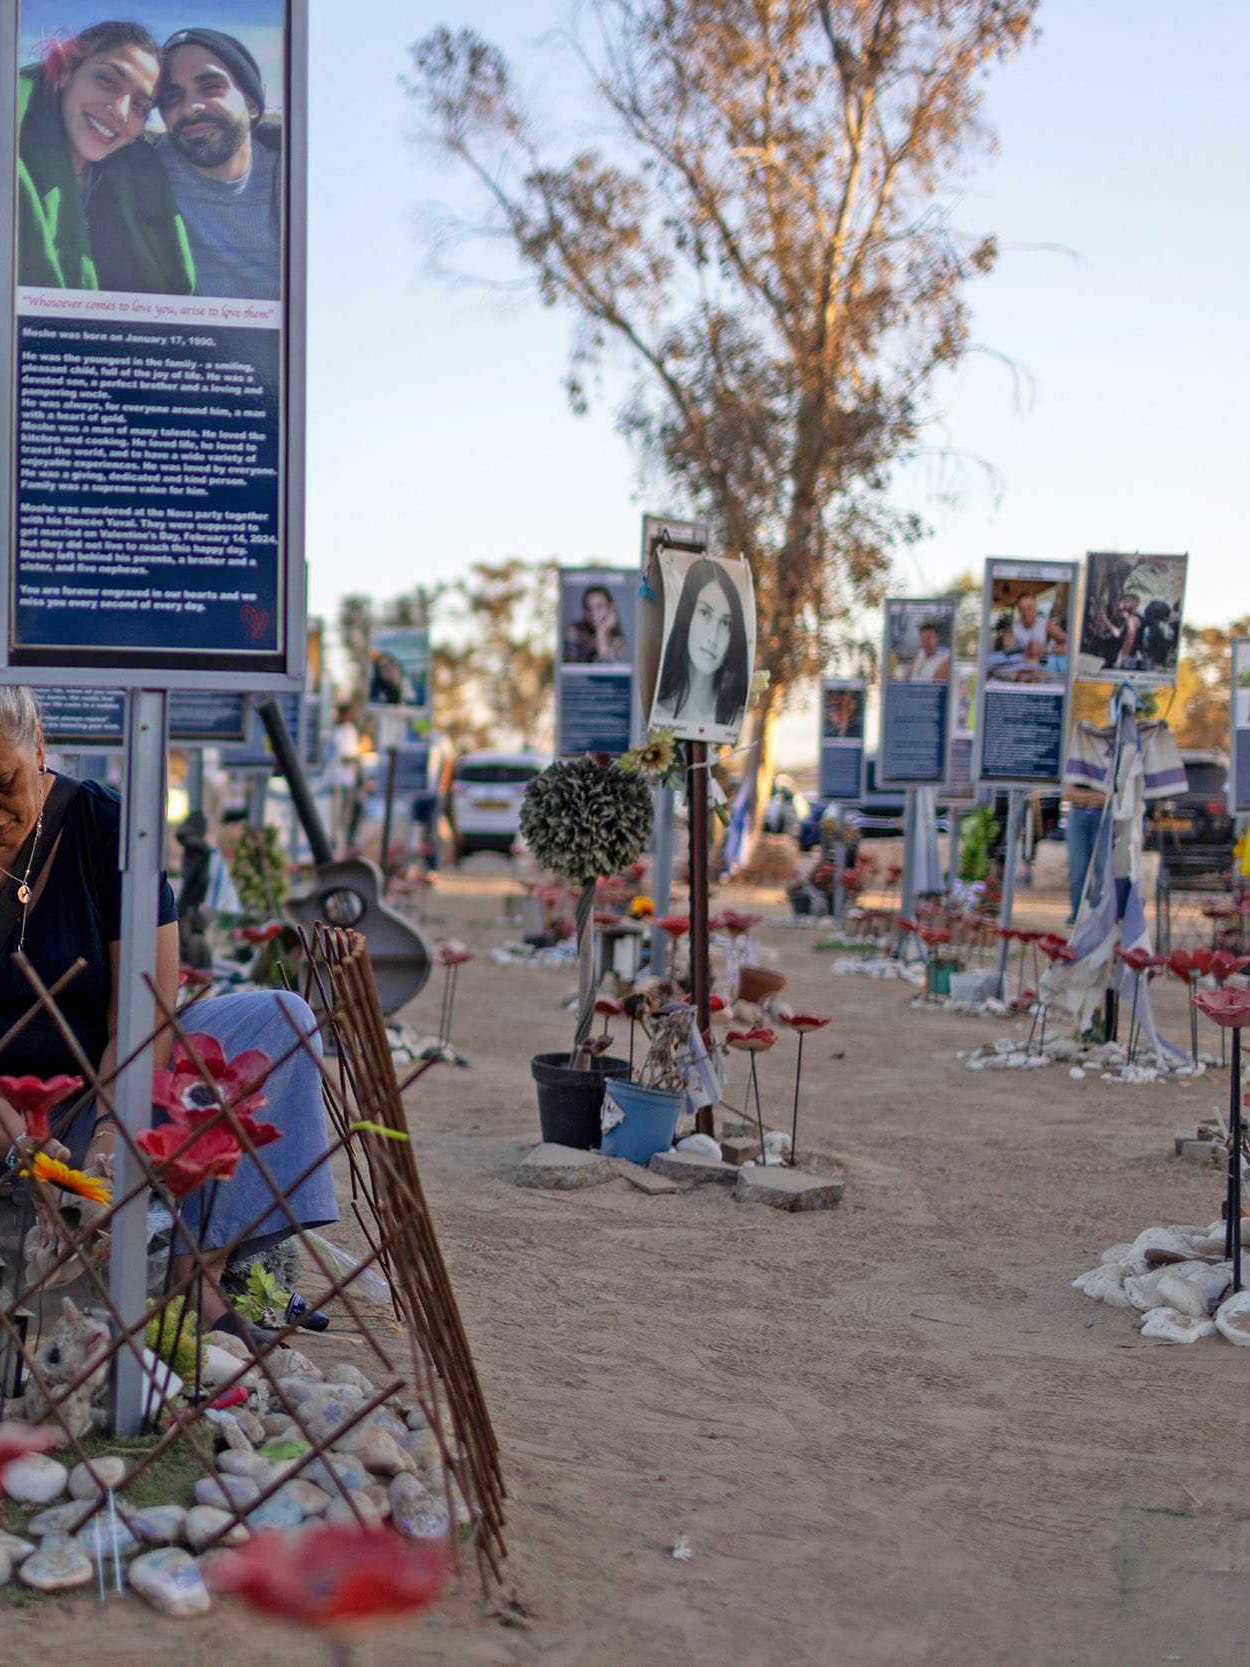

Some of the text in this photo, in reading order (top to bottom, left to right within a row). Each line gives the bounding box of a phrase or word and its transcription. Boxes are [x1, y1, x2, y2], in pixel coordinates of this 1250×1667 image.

[86, 300, 115, 310] comes
[119, 298, 129, 311] to
[132, 299, 151, 312] love
[155, 304, 177, 317] you,
[180, 302, 205, 315] arise
[208, 303, 218, 316] to
[221, 304, 240, 317] love
[244, 305, 274, 319] them"
[21, 326, 56, 338] Moshe
[59, 330, 80, 339] was
[83, 330, 107, 341] born
[109, 333, 122, 341] on
[125, 332, 167, 346] January
[188, 335, 216, 346] 1990.
[21, 350, 37, 360] He
[39, 352, 61, 362] was
[63, 352, 80, 363] the
[83, 353, 130, 367] youngest
[133, 355, 143, 366] in
[145, 356, 162, 367] the
[164, 357, 196, 370] family
[205, 361, 212, 369] a
[21, 385, 111, 399] pampering uncle.
[21, 396, 36, 407] He
[39, 399, 60, 408] was
[104, 400, 119, 411] for
[121, 403, 169, 415] everyone
[171, 403, 207, 415] around
[209, 405, 232, 418] him,
[234, 408, 241, 416] a
[243, 408, 266, 417] man
[20, 455, 277, 477] enjoyable experiences. He was loved by everyone.
[20, 467, 36, 477] He
[38, 469, 60, 478] was
[62, 470, 69, 478] a
[108, 470, 160, 482] dedicated
[162, 472, 181, 483] and
[184, 473, 206, 484] kind
[208, 475, 247, 487] person.
[19, 502, 269, 522] Moshe was murdered at the Nova party together
[19, 513, 43, 524] with
[45, 514, 62, 525] his
[106, 516, 138, 527] Yuval.
[140, 517, 166, 530] They
[168, 520, 194, 529] were
[196, 519, 245, 533] supposed
[247, 521, 259, 531] to
[19, 525, 37, 538] get
[40, 526, 81, 537] married
[83, 529, 97, 537] on
[183, 530, 229, 544] February
[55, 561, 75, 572] and
[77, 562, 96, 572] five
[98, 562, 149, 576] nephews.
[19, 584, 256, 600] You are forever engraved in our hearts and we
[19, 595, 206, 612] miss you every second of every day.
